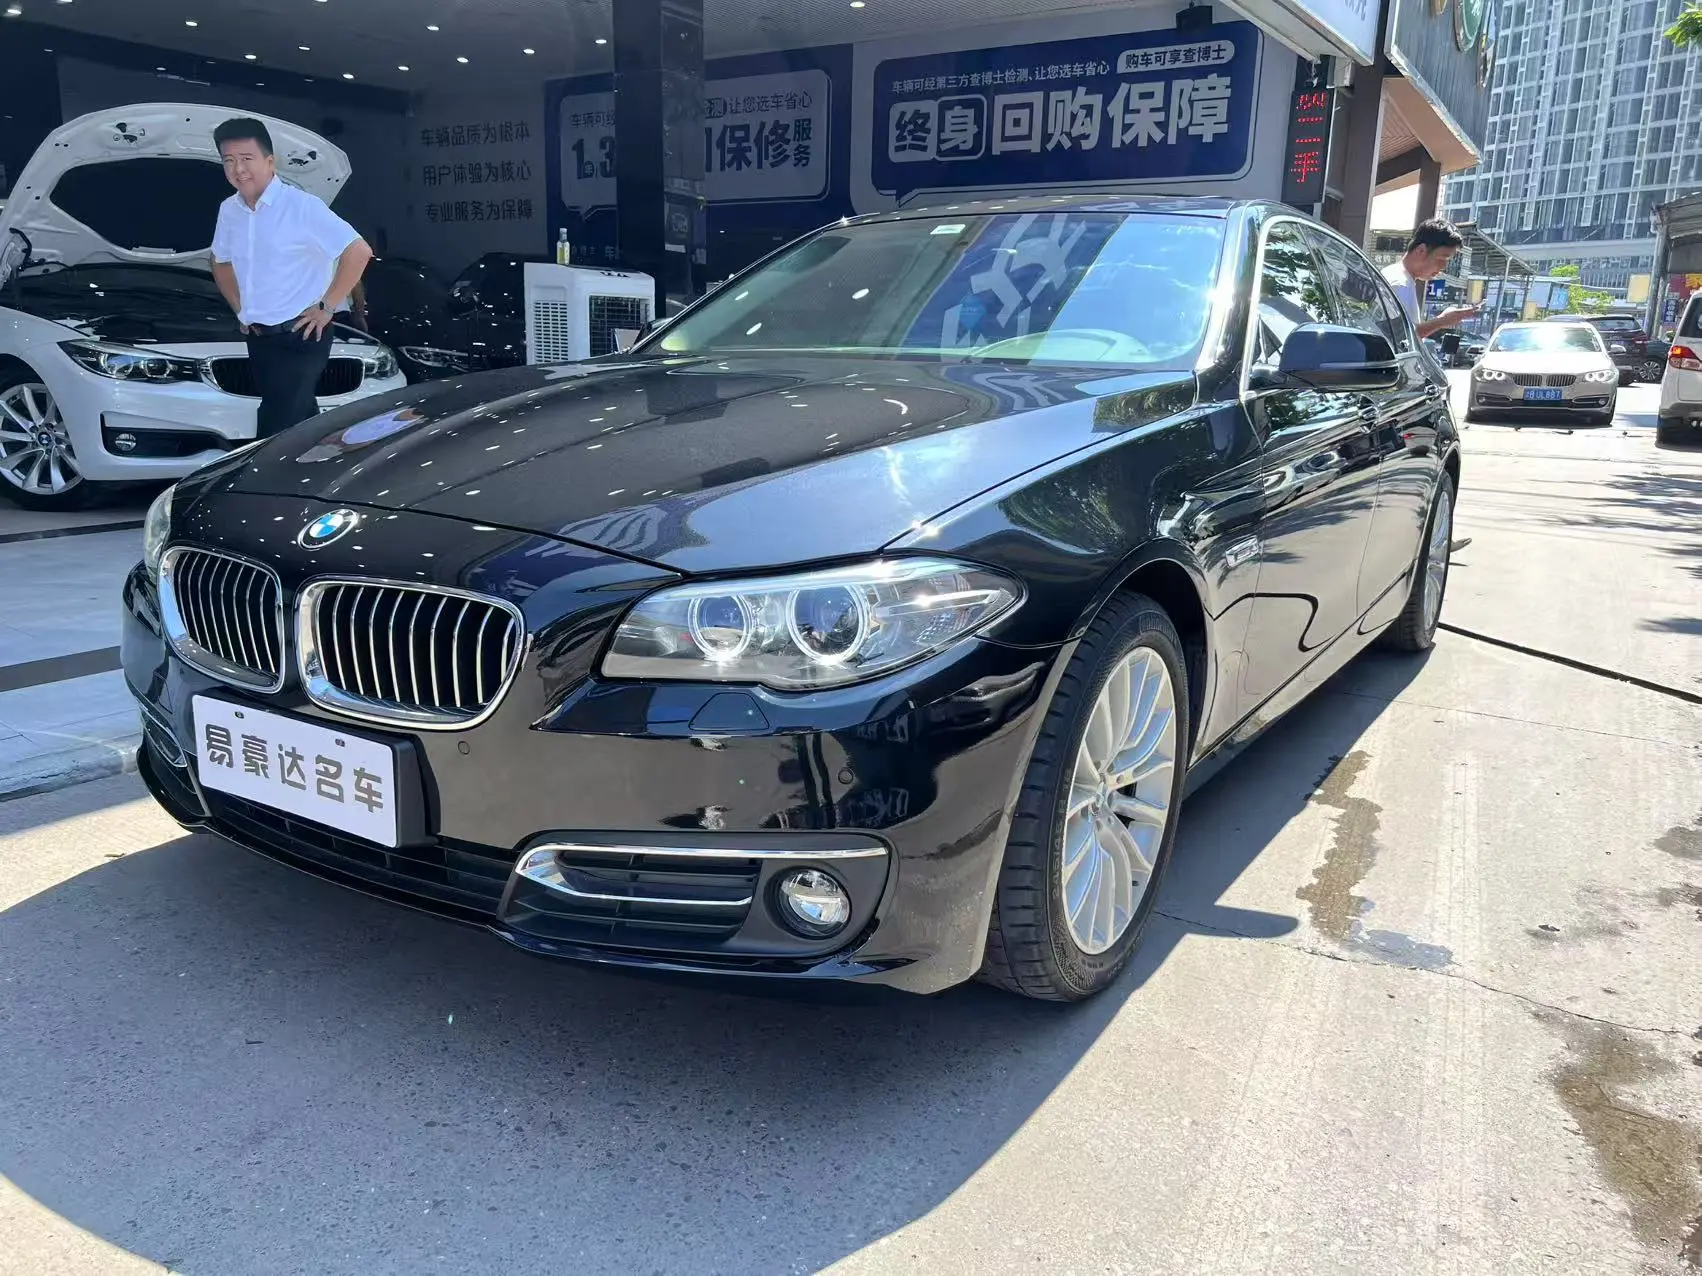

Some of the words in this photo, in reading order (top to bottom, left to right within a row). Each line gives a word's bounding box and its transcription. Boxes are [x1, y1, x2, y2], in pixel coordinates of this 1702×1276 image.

[1125, 44, 1227, 69] 购车可享查博士
[729, 91, 813, 114] 让您选车省心
[894, 73, 1232, 156] 终身回购保障
[420, 120, 530, 150] 车辆品质为根本
[704, 119, 791, 173] 保修
[423, 159, 532, 186] 用户体验为核心
[424, 198, 534, 223] 专业服务为保障
[204, 722, 384, 813] 易豪达名车
